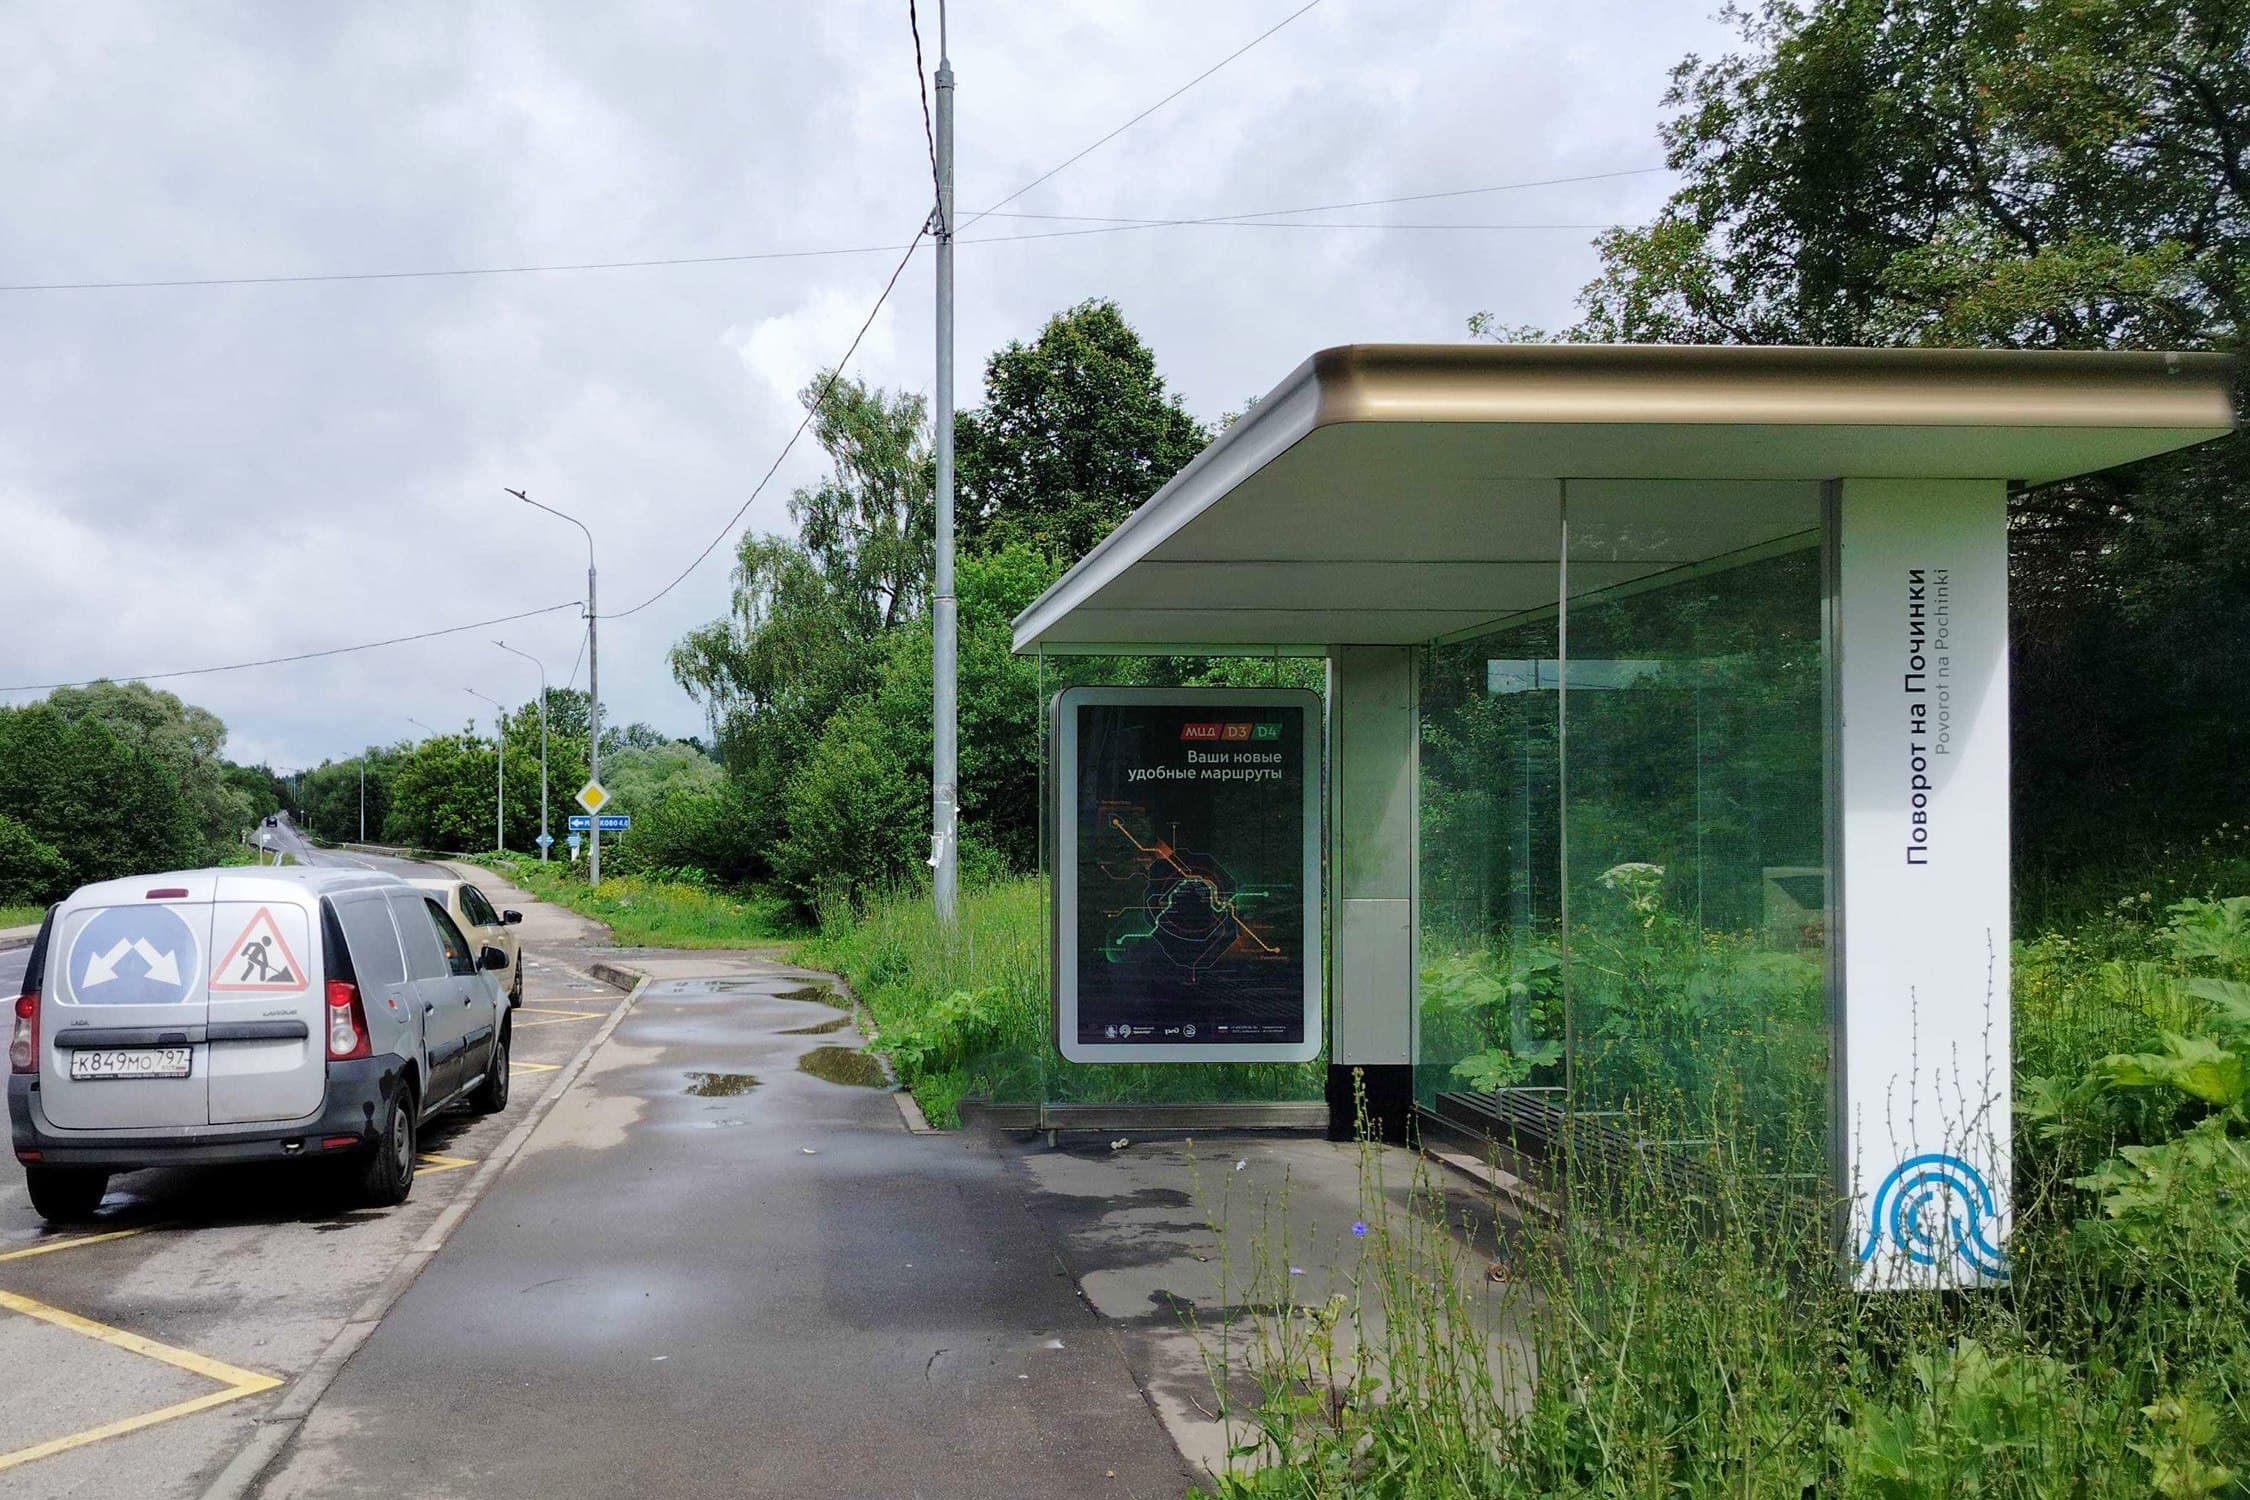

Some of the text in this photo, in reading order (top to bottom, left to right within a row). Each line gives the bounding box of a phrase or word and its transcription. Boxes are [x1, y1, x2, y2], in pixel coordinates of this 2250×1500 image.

[1933, 568, 1950, 755] Povorot na Pochinki
[1904, 569, 1932, 865] Поворот на Починки
[1227, 726, 1248, 738] D3
[1257, 726, 1277, 738] D4
[1187, 750, 1283, 764] Ваши новые
[1127, 765, 1283, 782] удобные маршруты
